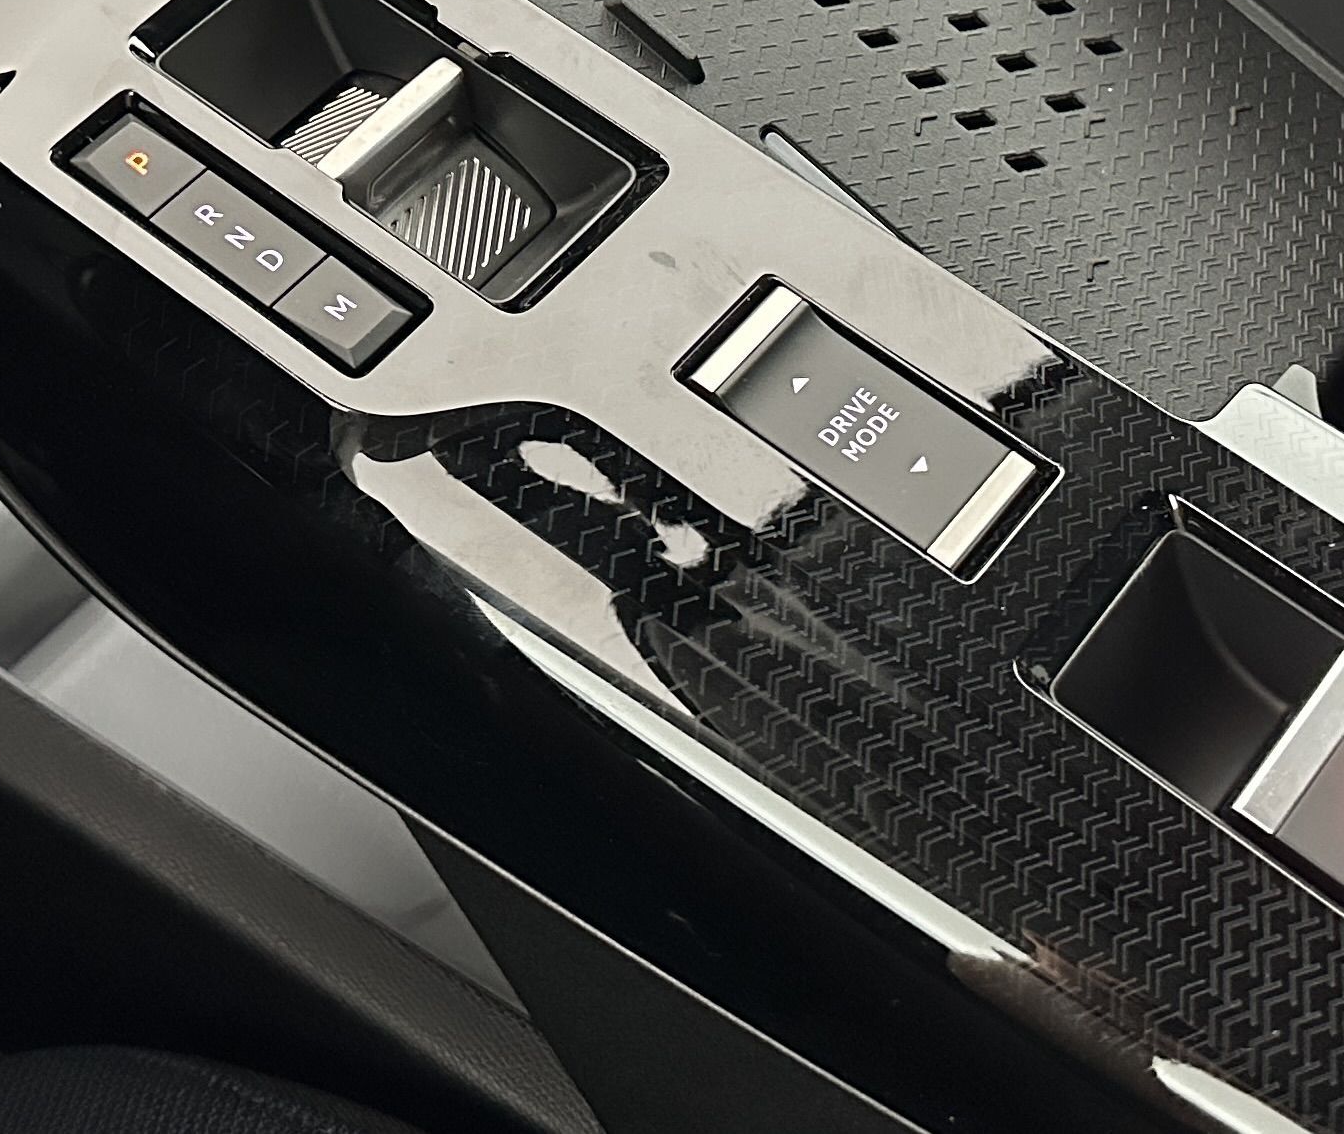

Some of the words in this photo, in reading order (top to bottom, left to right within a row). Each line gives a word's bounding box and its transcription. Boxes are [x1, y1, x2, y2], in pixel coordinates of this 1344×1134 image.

[125, 151, 150, 176] P
[194, 204, 224, 227] R
[224, 225, 255, 250] N
[255, 249, 284, 272] D
[323, 294, 358, 321] M
[817, 387, 878, 447] DRIVE
[841, 403, 900, 462] MODE
